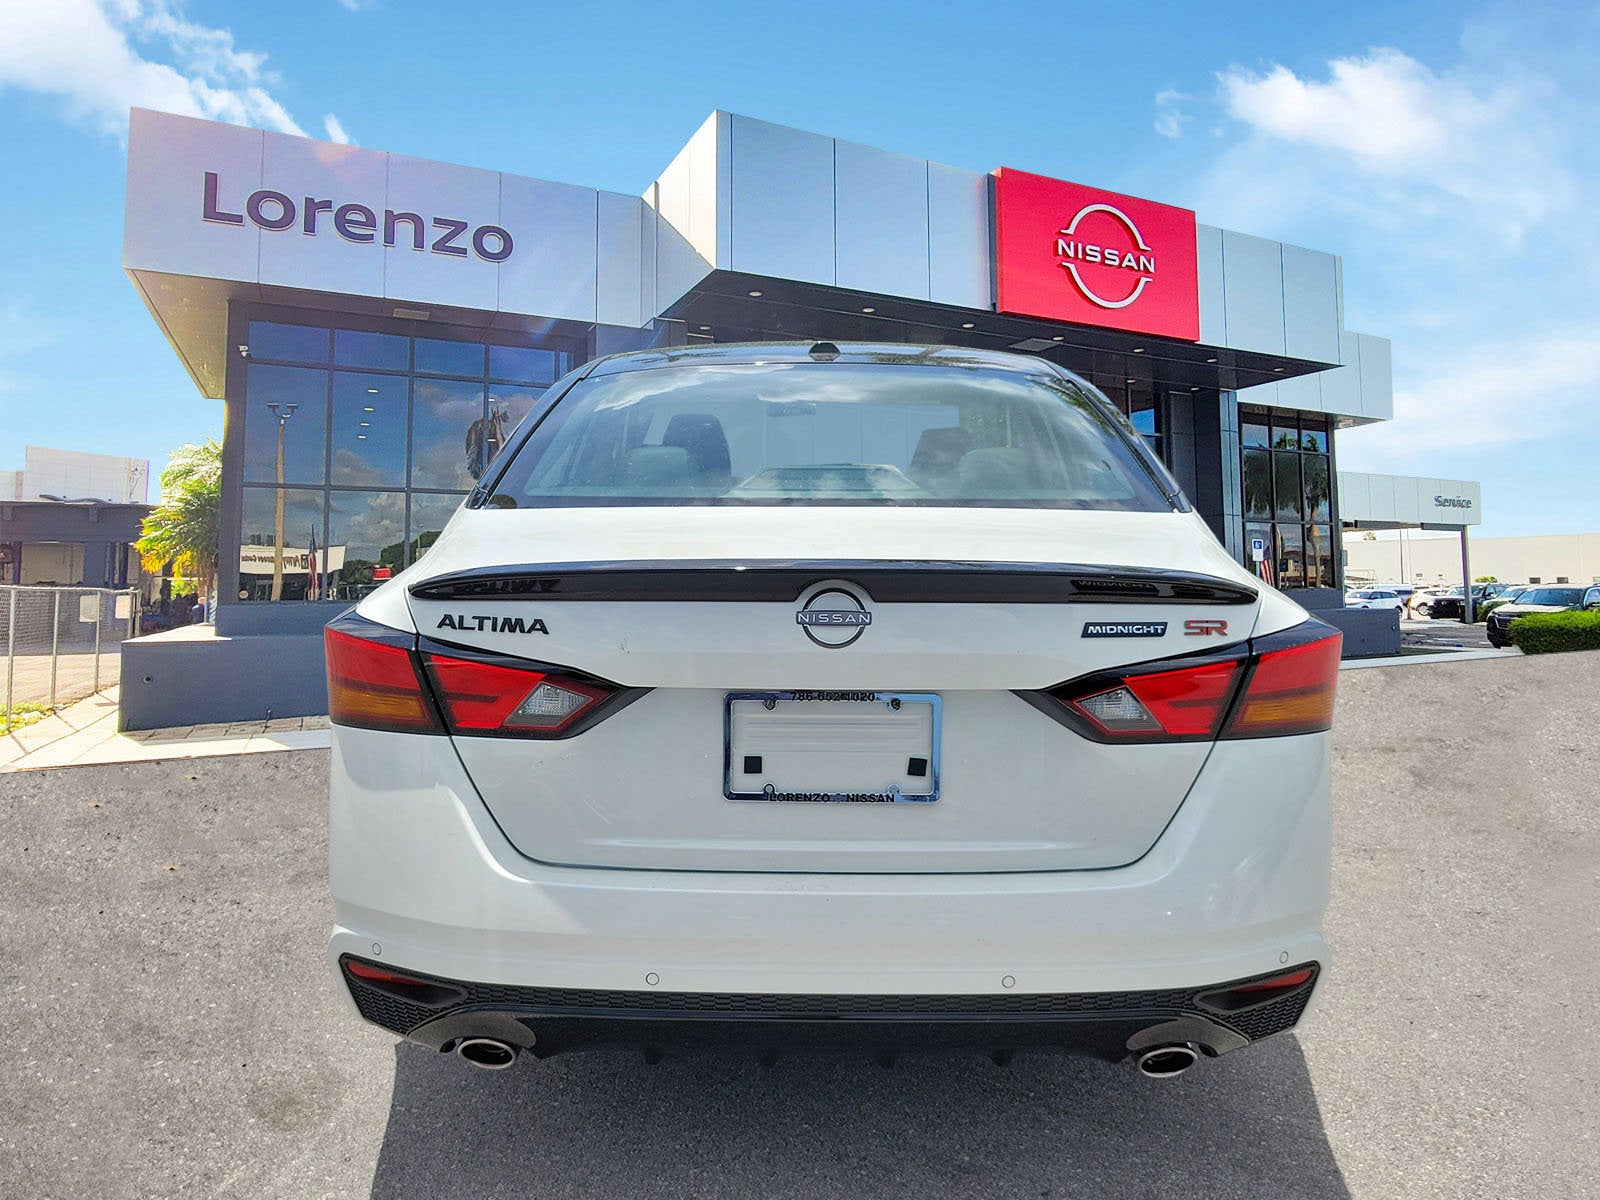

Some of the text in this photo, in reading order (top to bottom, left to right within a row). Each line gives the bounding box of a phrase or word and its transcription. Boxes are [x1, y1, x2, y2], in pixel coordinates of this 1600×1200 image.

[202, 171, 514, 263] Lorenzo
[1056, 238, 1155, 273] NISSAN
[1434, 495, 1472, 509] Service
[436, 614, 550, 635] ALTIMA
[798, 613, 871, 623] NISSAN
[1087, 620, 1228, 636] MIDNIGHT SR
[769, 793, 895, 803] LORENZO NISSAN
